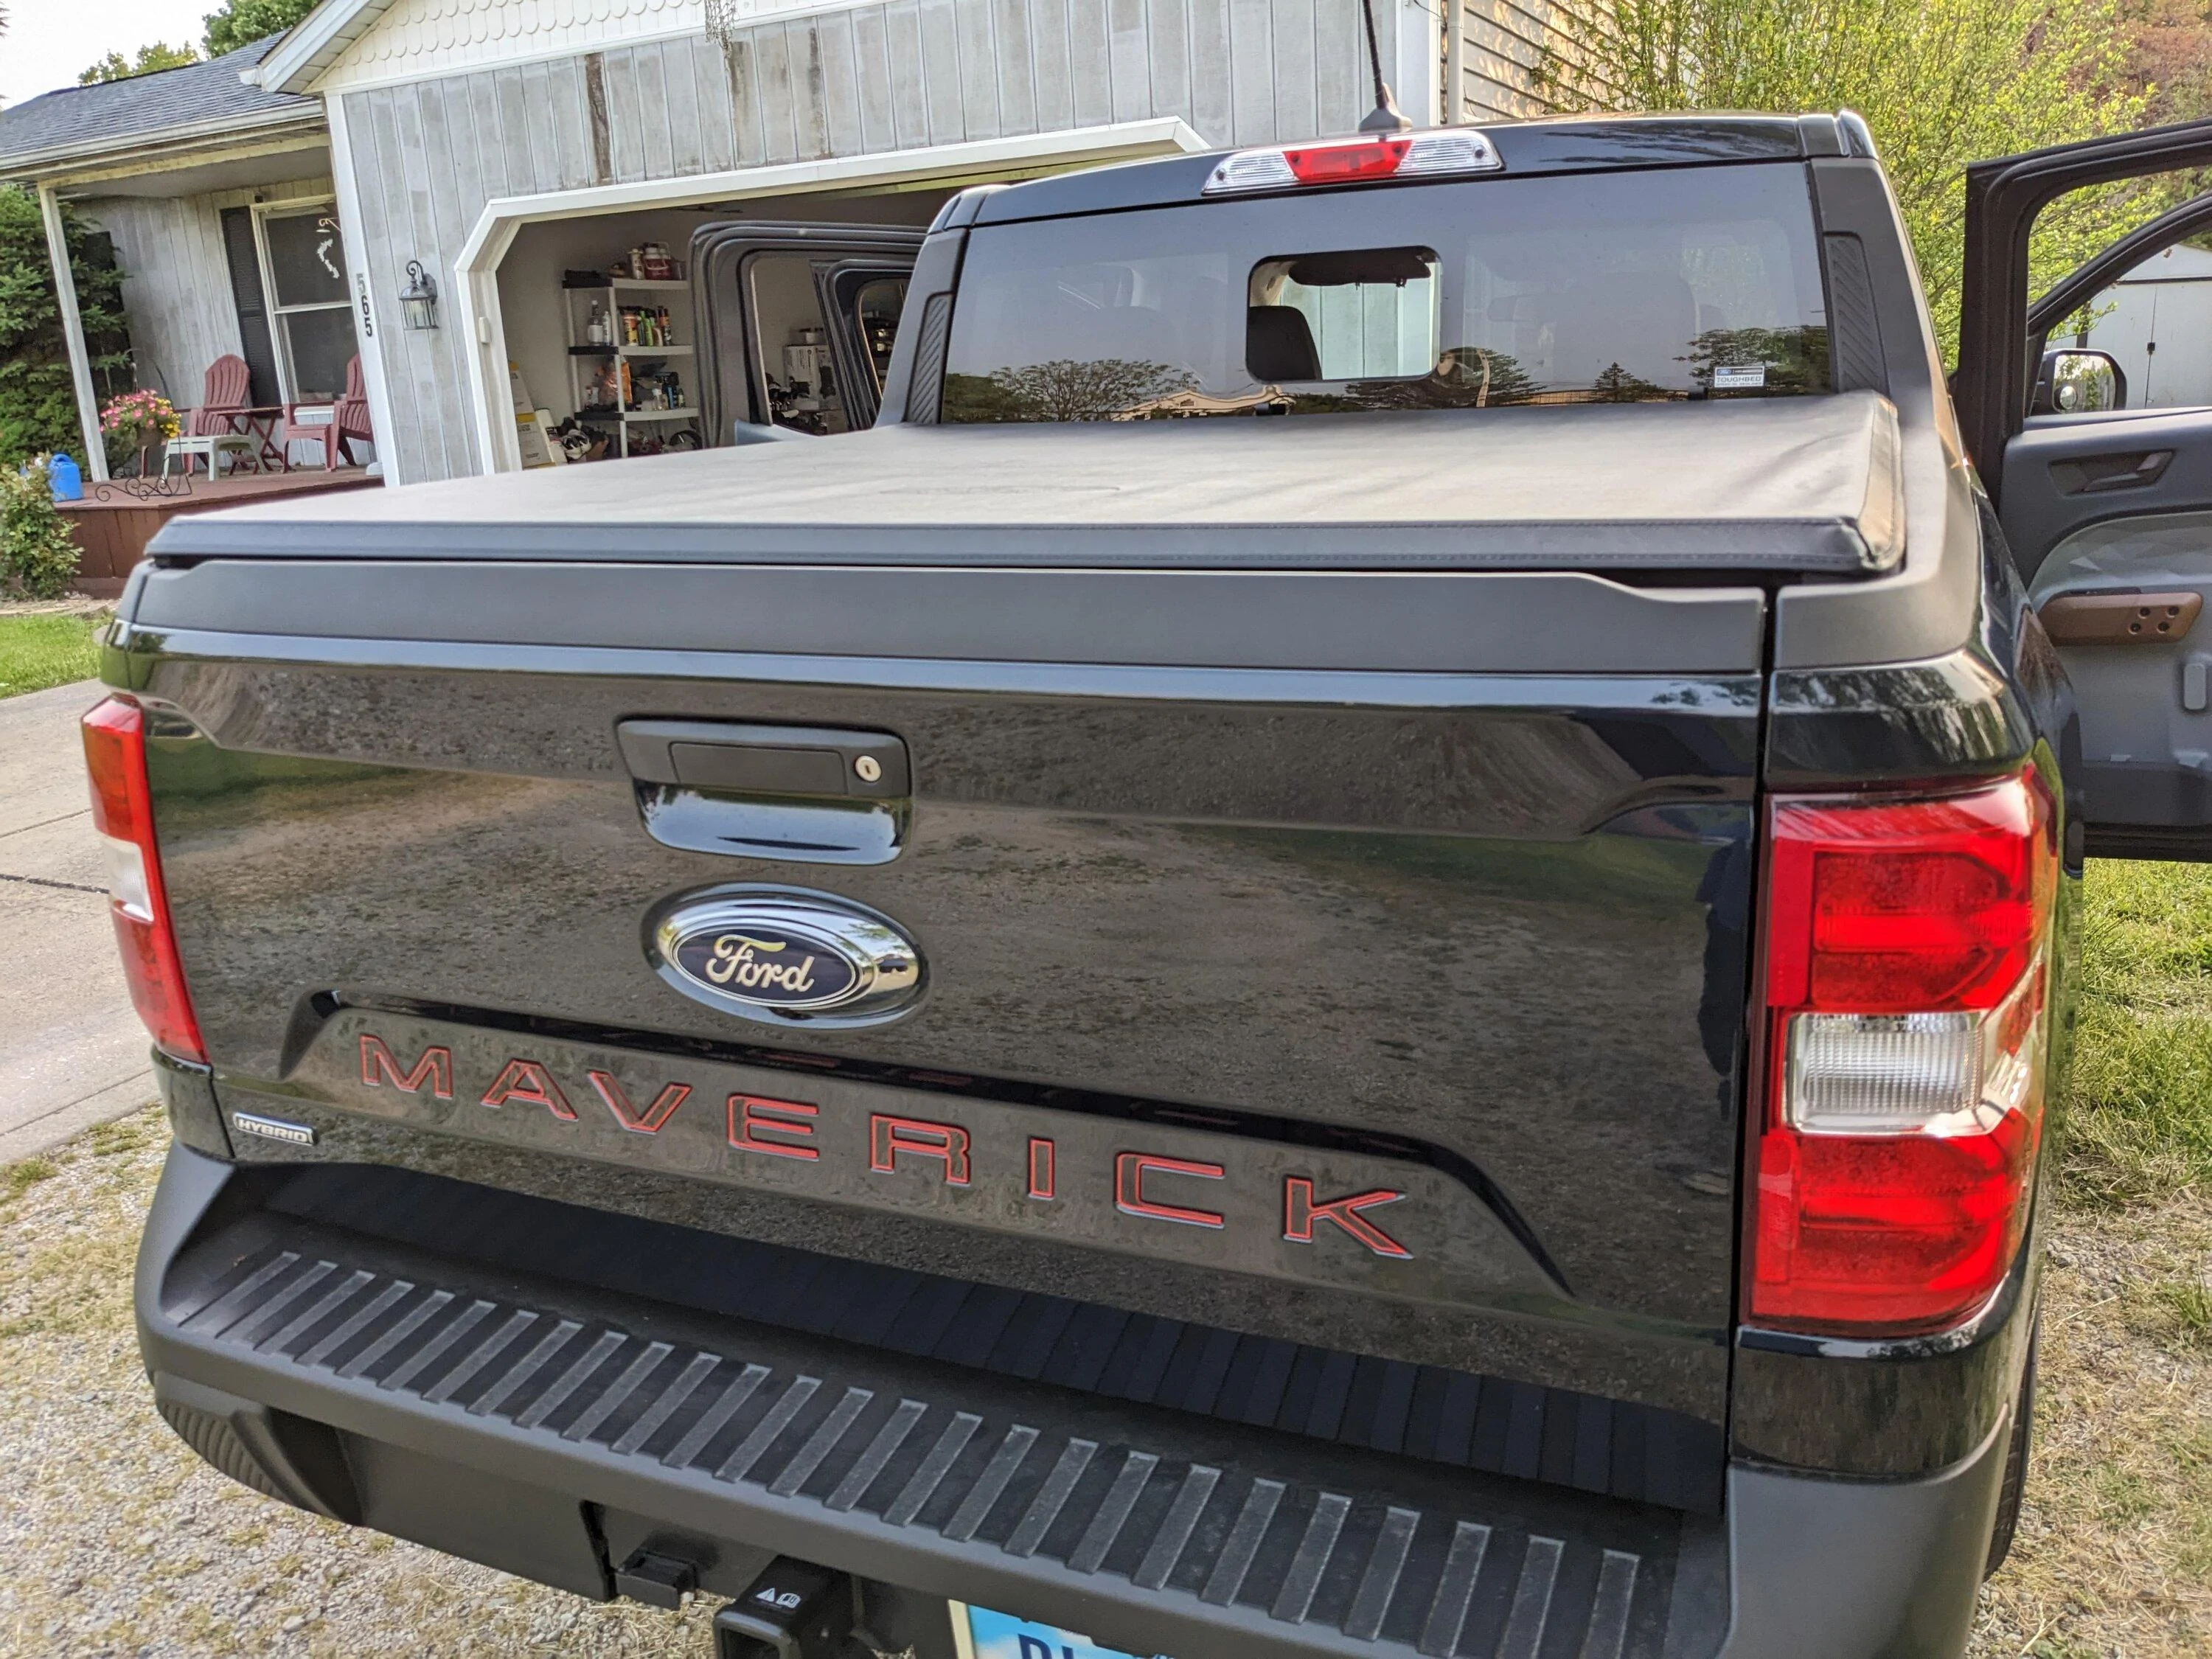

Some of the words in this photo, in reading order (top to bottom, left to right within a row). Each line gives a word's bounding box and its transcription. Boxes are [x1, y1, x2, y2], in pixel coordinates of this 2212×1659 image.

[356, 273, 373, 337] 565
[706, 934, 815, 992] Ford
[238, 1119, 307, 1142] HYBRID
[359, 1034, 1413, 1259] MAVERICK
